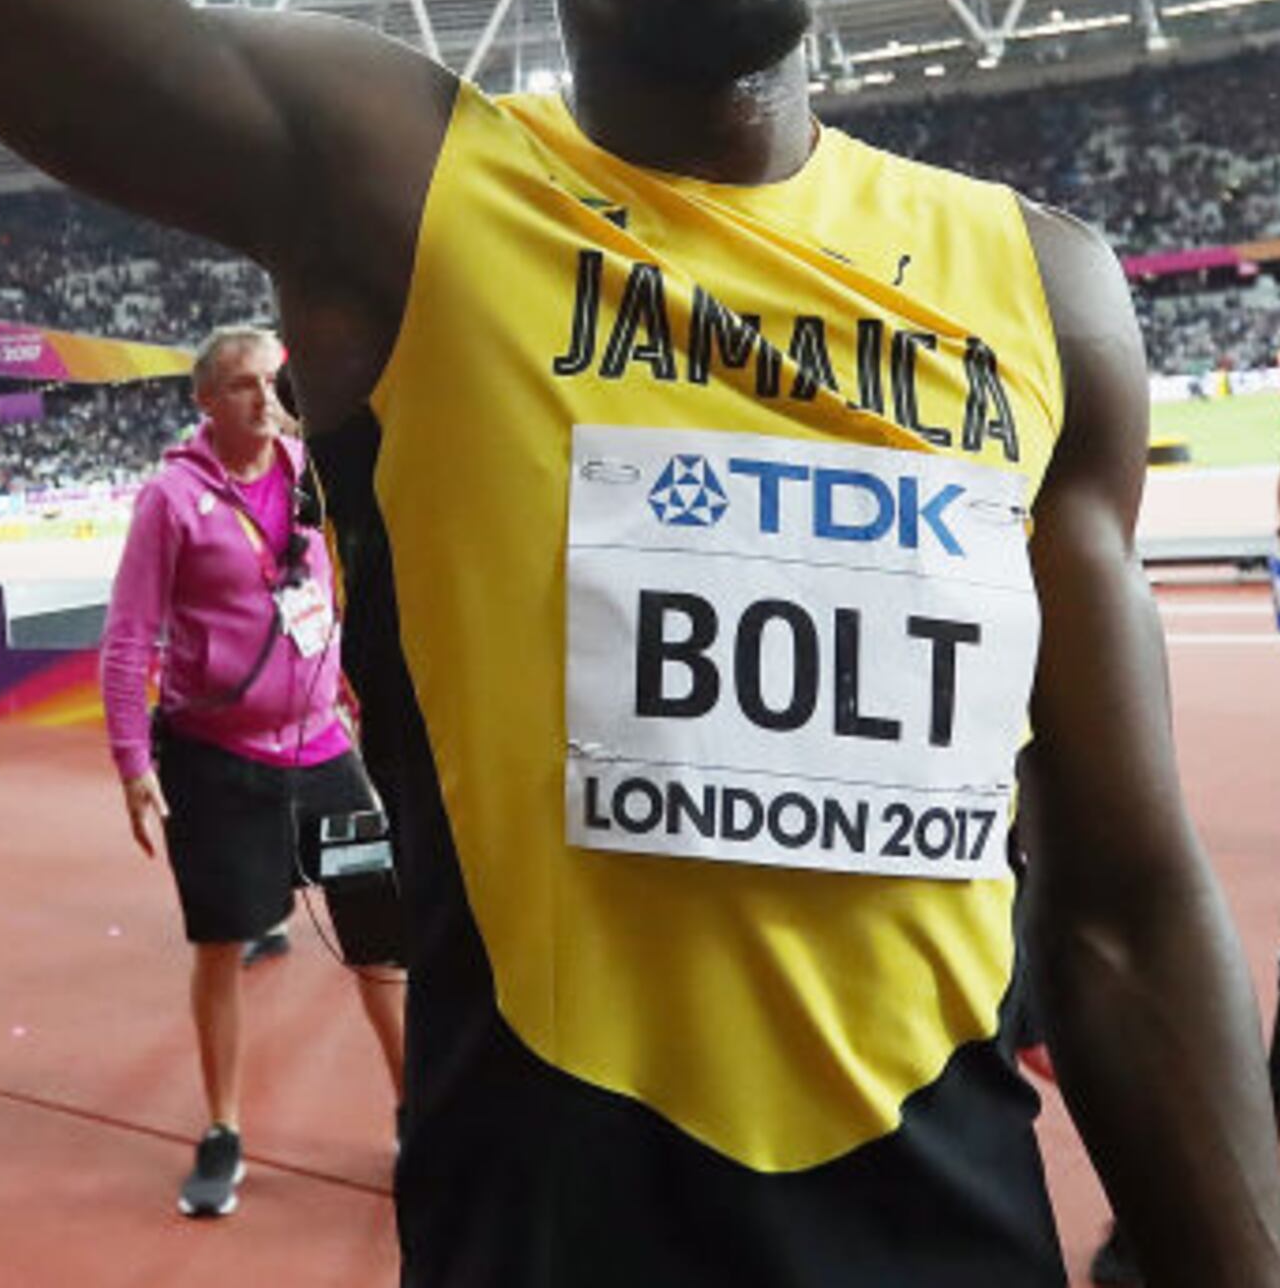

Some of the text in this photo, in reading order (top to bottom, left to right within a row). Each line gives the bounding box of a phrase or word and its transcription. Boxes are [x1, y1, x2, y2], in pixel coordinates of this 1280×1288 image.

[552, 249, 1020, 463] JAMAICA
[728, 456, 968, 558] TDK
[633, 588, 982, 749] BOLT
[583, 776, 998, 862] LONDON 2017
